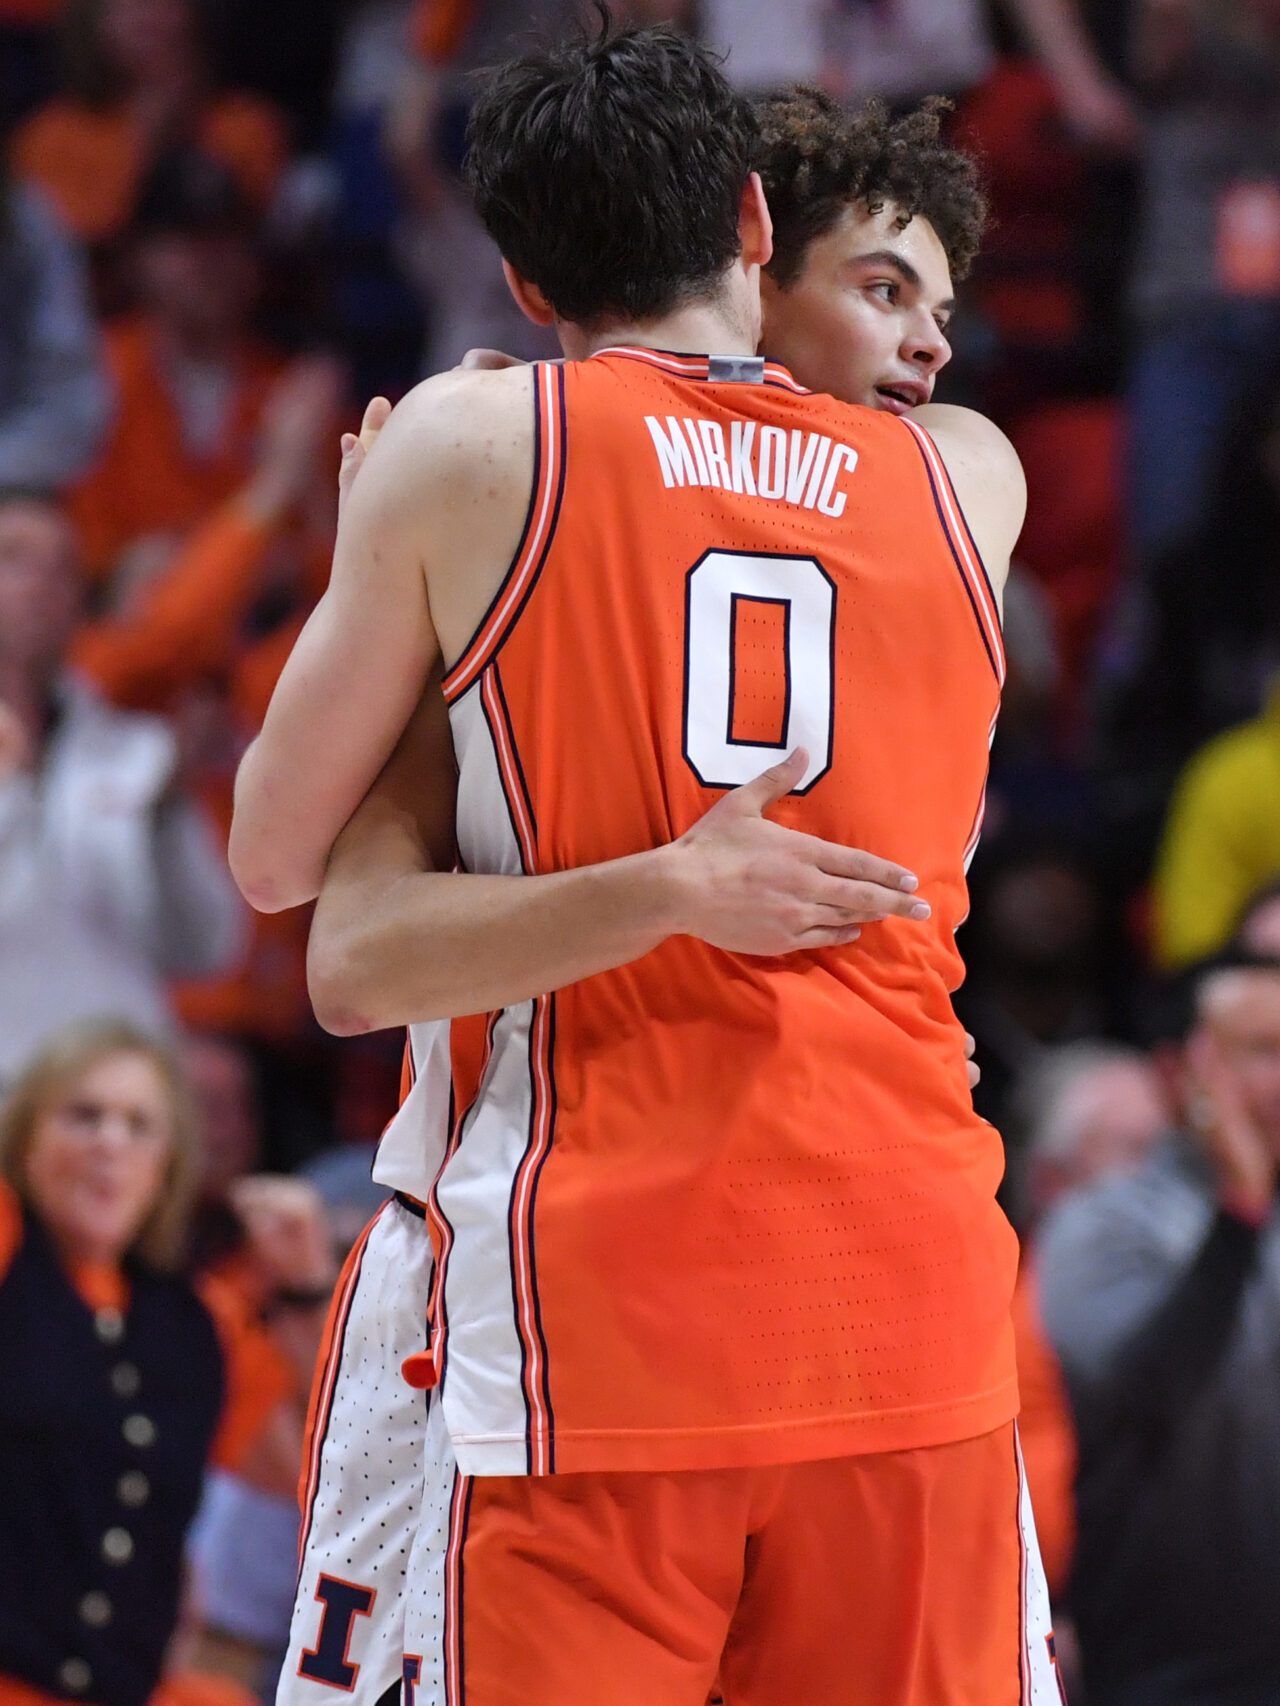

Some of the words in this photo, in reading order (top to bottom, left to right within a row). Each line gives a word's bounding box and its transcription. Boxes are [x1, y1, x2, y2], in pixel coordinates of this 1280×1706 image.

[644, 416, 859, 518] MIRKOVIC
[682, 547, 838, 797] 0
[297, 1572, 377, 1692] I
